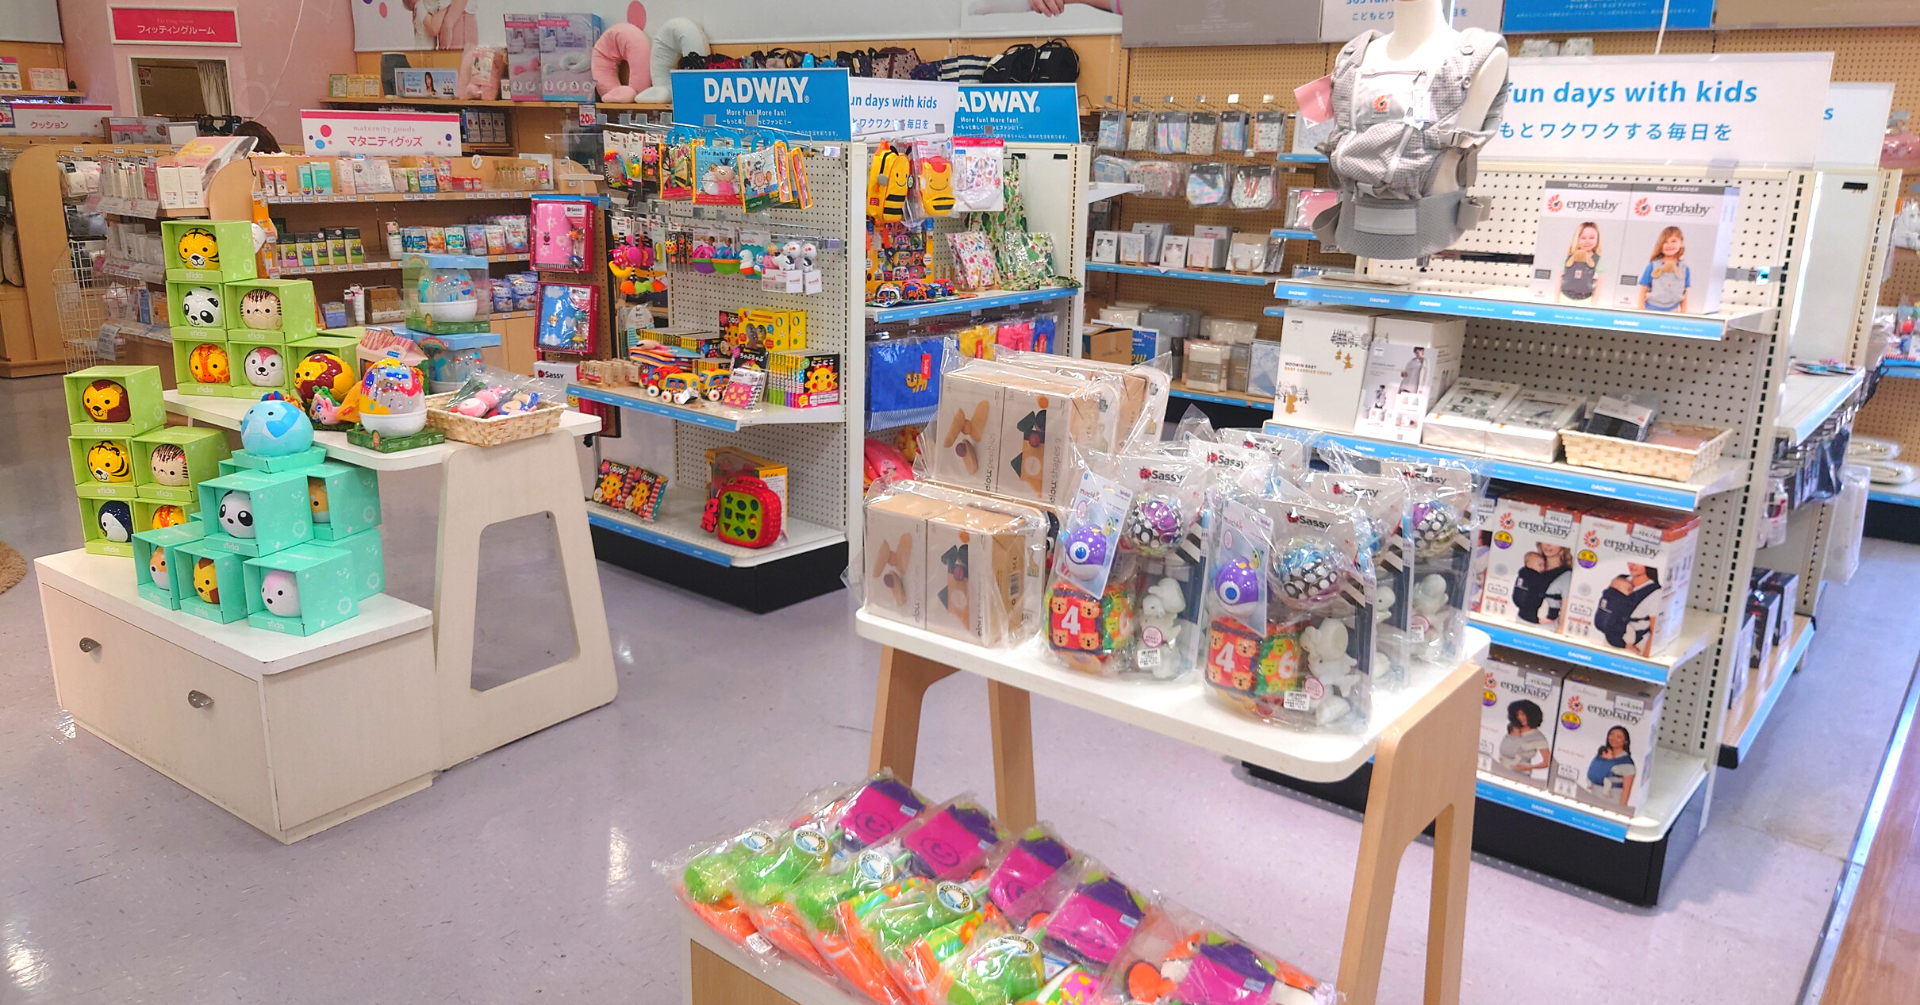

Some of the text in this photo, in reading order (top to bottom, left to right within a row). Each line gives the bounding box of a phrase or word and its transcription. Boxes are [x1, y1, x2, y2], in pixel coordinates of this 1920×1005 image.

[137, 25, 216, 35] フィッティングルーム
[703, 76, 810, 104] DADWAY
[1553, 81, 1616, 108] days
[1624, 80, 1687, 103] with
[1696, 79, 1758, 103] kids
[850, 94, 938, 109] un days with kids
[956, 91, 1040, 113] ADWAY
[726, 108, 741, 116] More
[742, 108, 755, 116] fun!
[30, 121, 69, 129] クッション
[960, 116, 975, 124] More
[976, 116, 989, 124] fun!
[353, 124, 416, 133] maternity goods
[346, 136, 423, 147] マタニティグッズ
[1566, 198, 1619, 214] ergobaby
[1655, 203, 1711, 218] ergobaby
[186, 271, 203, 280] sfida
[190, 330, 207, 338] sfida
[247, 331, 265, 341] sfida
[811, 358, 834, 367] にこにこ
[1131, 353, 1147, 364] ew
[545, 371, 565, 379] Sassy
[196, 386, 214, 395] sfida
[93, 425, 113, 434] sfida
[1217, 455, 1245, 469] Sassy
[1151, 470, 1183, 484] Sassy
[97, 486, 116, 496] sfida
[156, 489, 173, 499] sfida
[1299, 513, 1331, 529] Sassy
[1518, 519, 1572, 539] ergobaby
[103, 545, 120, 555] sfida
[223, 541, 239, 552] sfida
[1603, 536, 1660, 560] ergobaby
[266, 620, 285, 631] sfida
[1060, 605, 1081, 636] 4
[1214, 641, 1236, 673] 4
[1278, 650, 1297, 679] 6
[1500, 681, 1550, 701] ergobaby
[1587, 702, 1642, 726] ergobaby
